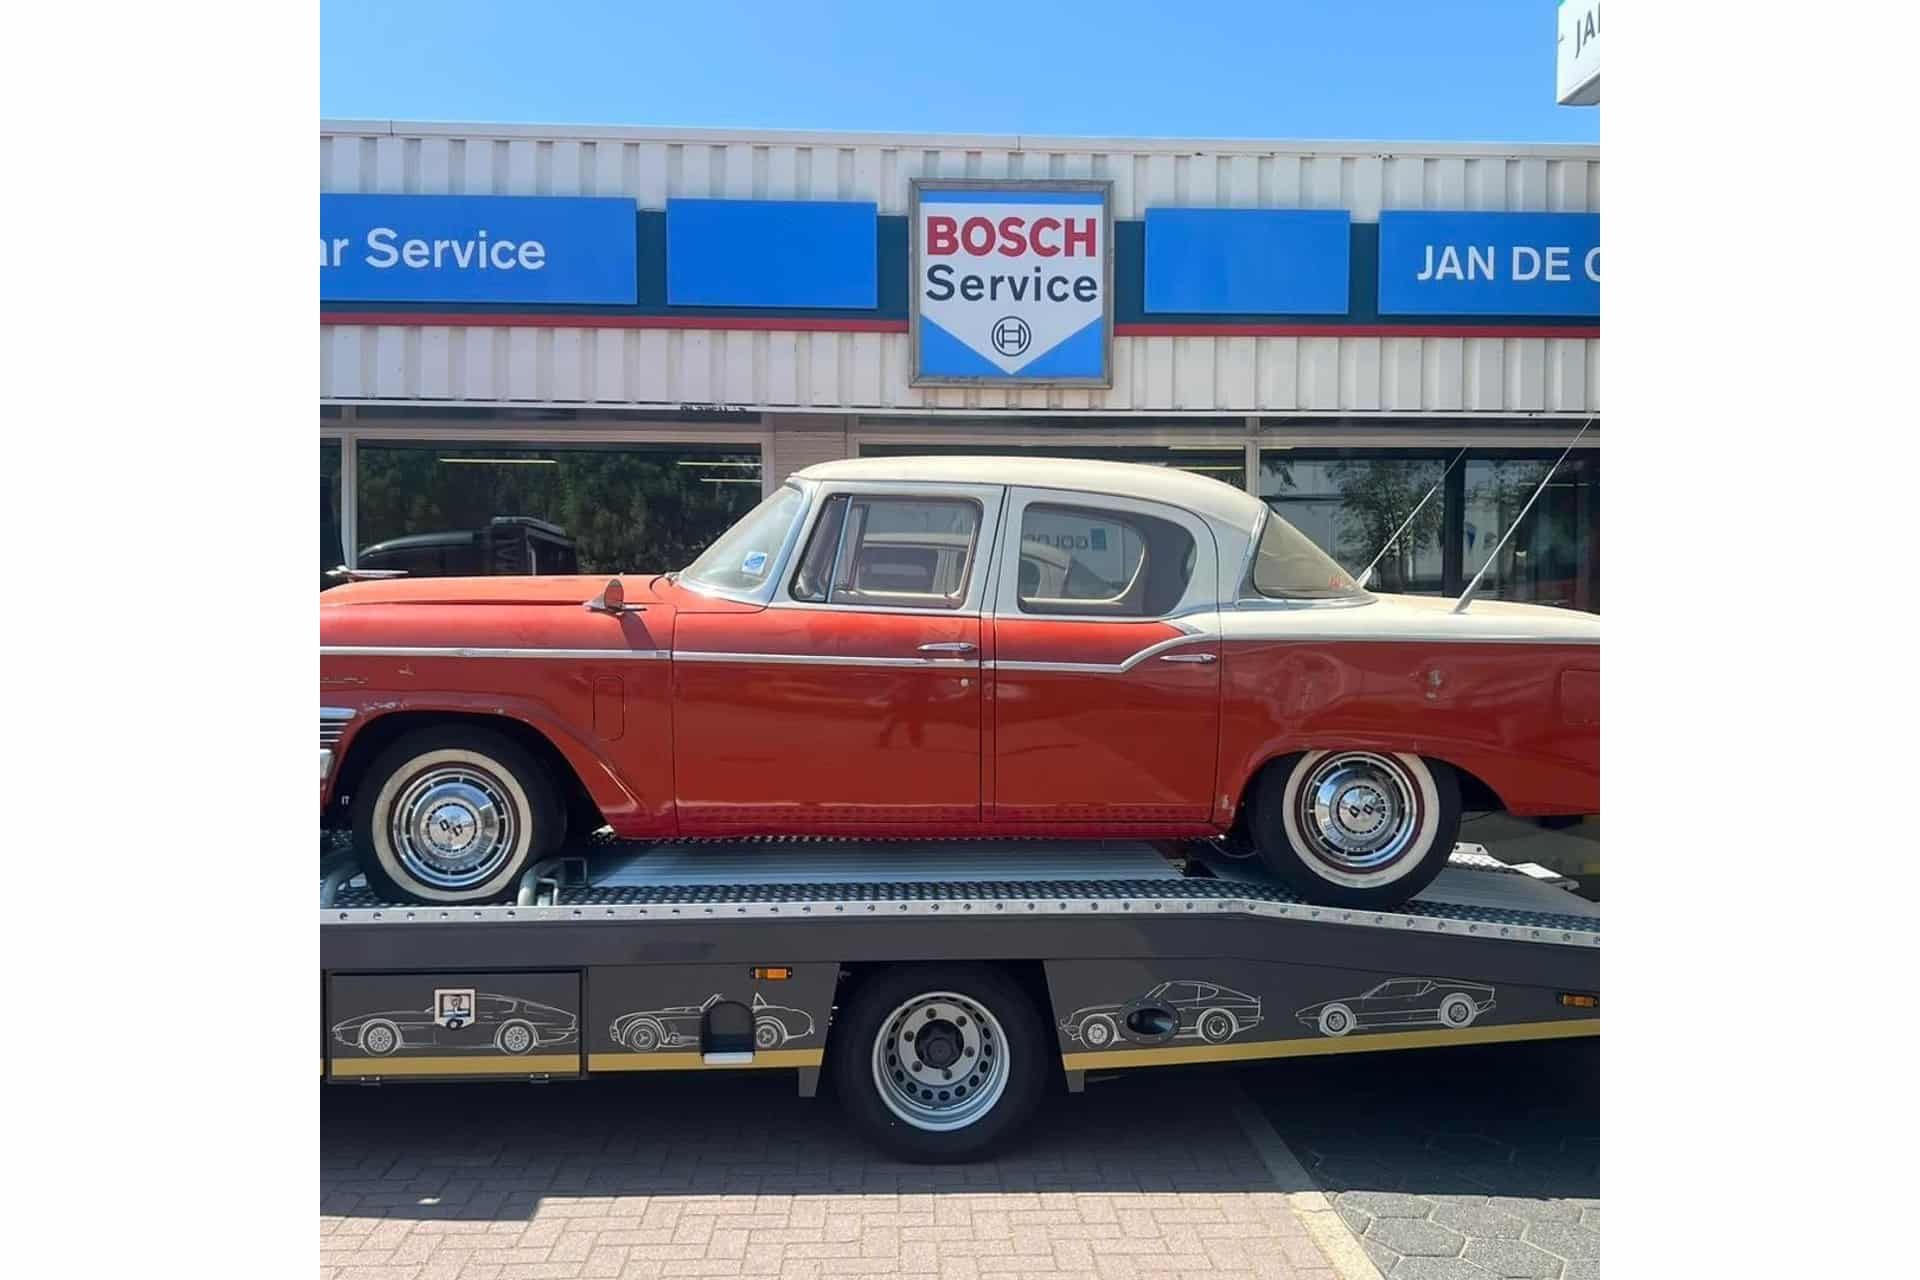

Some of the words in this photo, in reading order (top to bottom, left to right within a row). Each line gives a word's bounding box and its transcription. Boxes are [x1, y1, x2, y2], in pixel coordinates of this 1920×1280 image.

[1575, 1, 1600, 58] JA
[365, 227, 546, 269] Service
[926, 216, 1097, 257] BOSCH
[926, 264, 1097, 302] Service
[1417, 245, 1495, 281] JAN
[1512, 246, 1571, 281] DE
